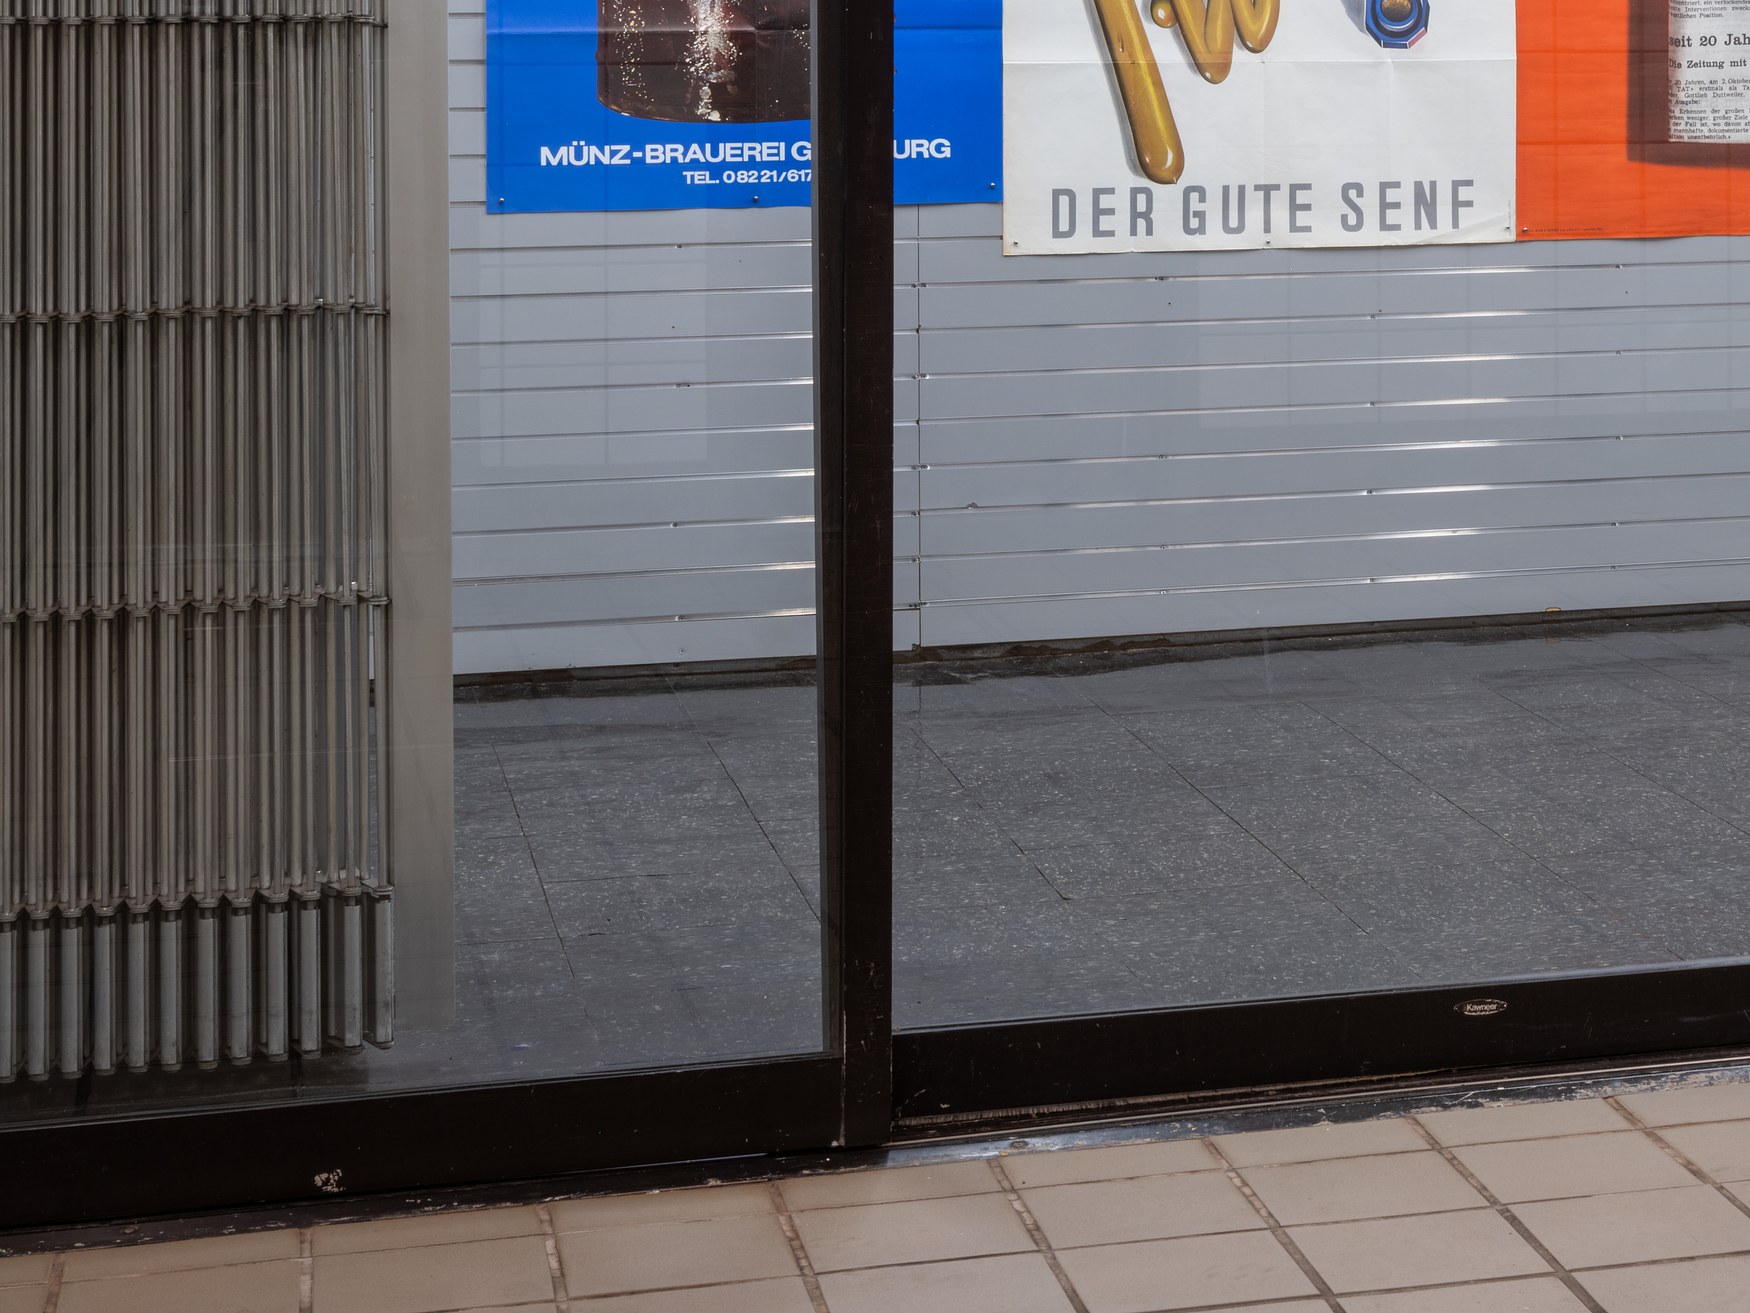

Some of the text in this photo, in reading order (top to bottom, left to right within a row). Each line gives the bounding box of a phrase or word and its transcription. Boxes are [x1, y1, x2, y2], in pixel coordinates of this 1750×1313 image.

[1700, 36, 1717, 46] 20
[1687, 60, 1724, 70] Zeitung
[1730, 58, 1747, 67] mit
[540, 138, 951, 166] MÜNZ-BRAUEREI GURG
[683, 171, 719, 184] TEL.
[1051, 187, 1153, 238] DER
[1182, 183, 1312, 236] GUTE
[1340, 180, 1474, 232] SENF
